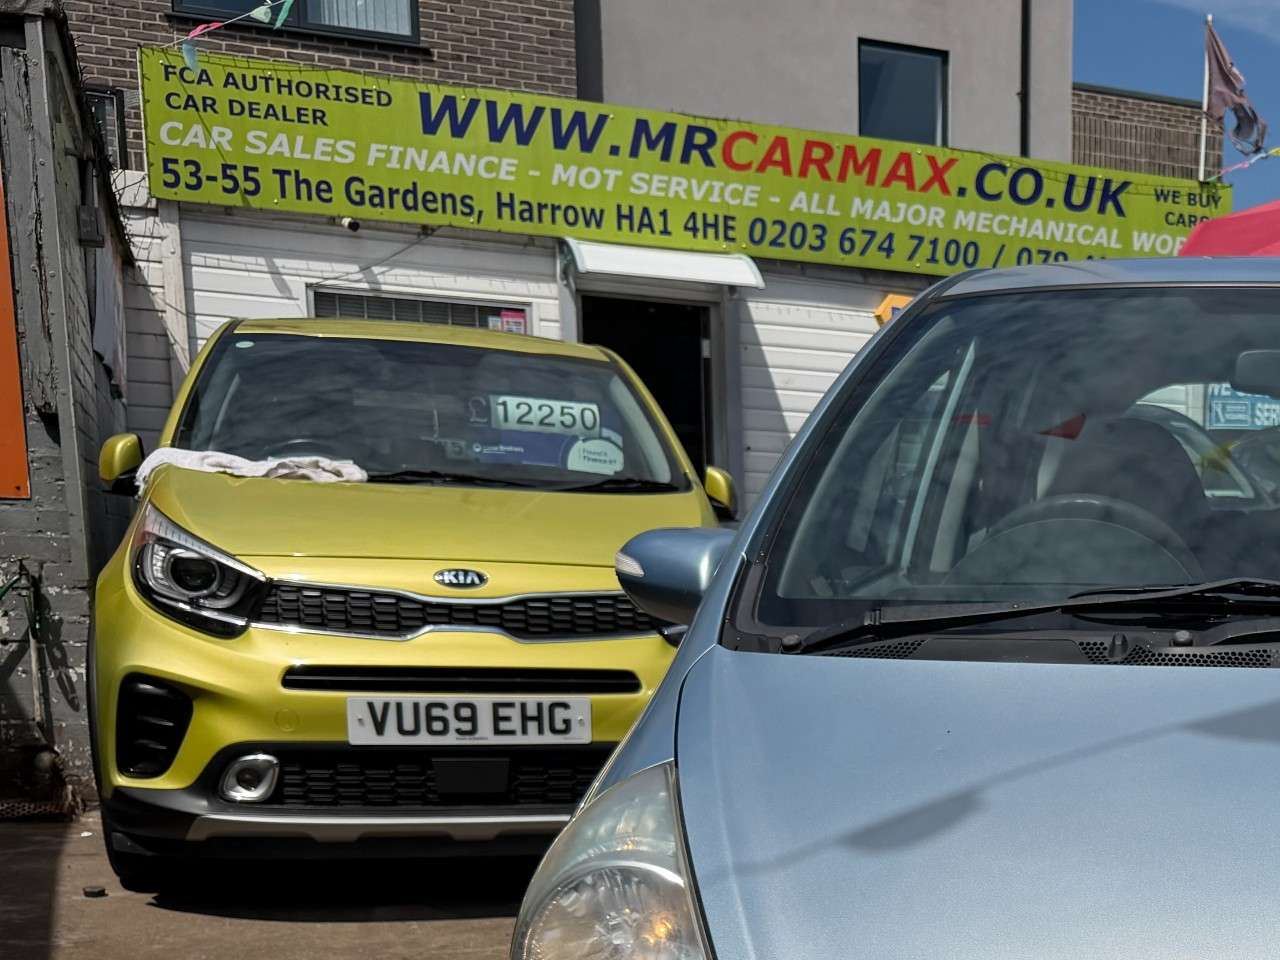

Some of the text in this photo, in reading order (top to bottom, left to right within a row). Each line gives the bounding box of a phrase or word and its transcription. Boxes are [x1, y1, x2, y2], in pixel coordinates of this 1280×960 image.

[162, 64, 393, 109] FCA AUTHORISED
[164, 91, 329, 127] CAR DEALER
[418, 91, 1133, 218] WWW.MRCARMAX.CO.UK
[159, 122, 234, 151] CAR
[244, 130, 356, 164] SALES
[366, 143, 518, 182] FINANCE
[551, 164, 622, 192] MOT
[629, 171, 761, 208] SERVICE
[789, 190, 841, 217] ALL
[851, 195, 945, 228] MAJOR
[953, 210, 1123, 250] MECHANICAL
[1132, 231, 1188, 256] WOR
[1154, 188, 1222, 209] WE BUY
[161, 157, 262, 197] 53-55
[272, 168, 333, 204] The
[343, 176, 484, 224] Gardens,
[496, 191, 605, 230] Harrow
[616, 204, 670, 237] HA1
[684, 216, 737, 244] 4HE
[748, 217, 828, 253] 0203
[839, 227, 896, 260] 674
[907, 235, 981, 270] 7100
[496, 400, 597, 431] 12250
[442, 571, 481, 584] KIA
[366, 701, 572, 737] VU69 EHG
